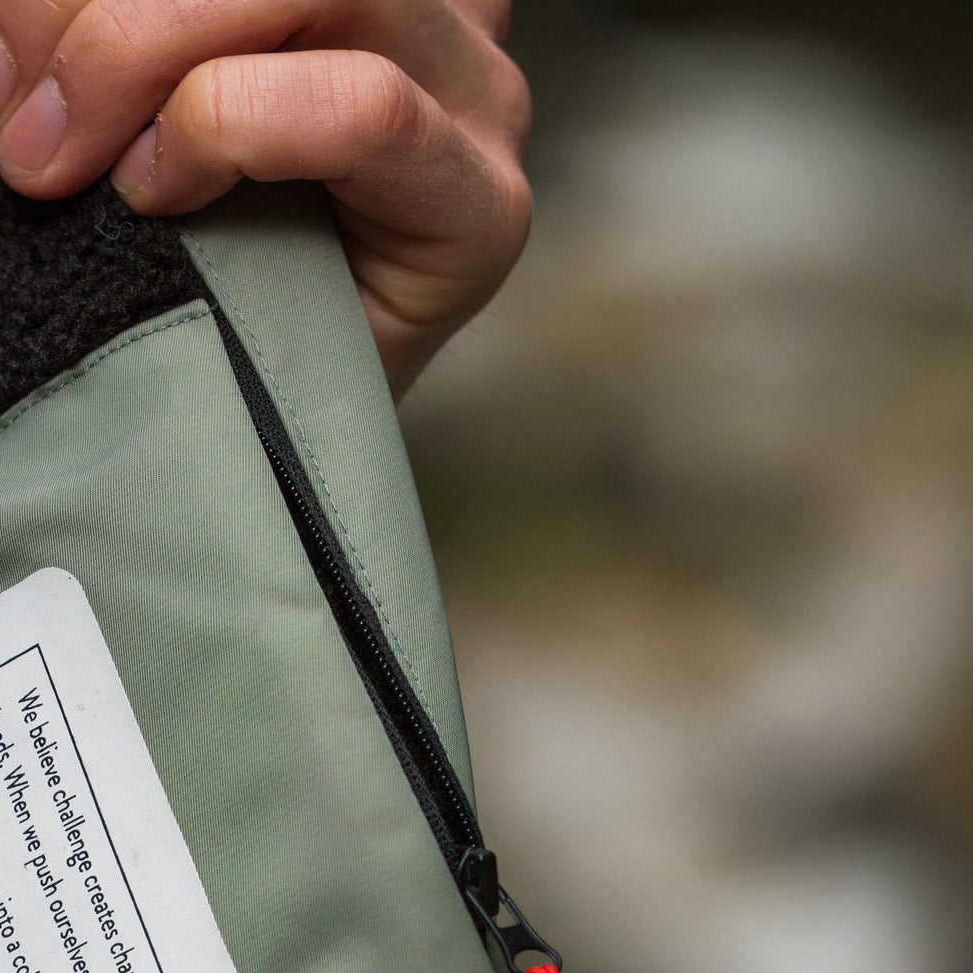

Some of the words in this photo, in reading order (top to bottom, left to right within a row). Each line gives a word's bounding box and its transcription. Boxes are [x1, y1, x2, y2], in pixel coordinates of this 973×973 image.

[18, 687, 43, 724] We
[29, 721, 61, 788] believe
[3, 764, 31, 824] When
[22, 824, 41, 852] we
[53, 789, 92, 873] challenge
[24, 854, 64, 898] push
[84, 875, 119, 940] creates
[6, 941, 20, 954] a
